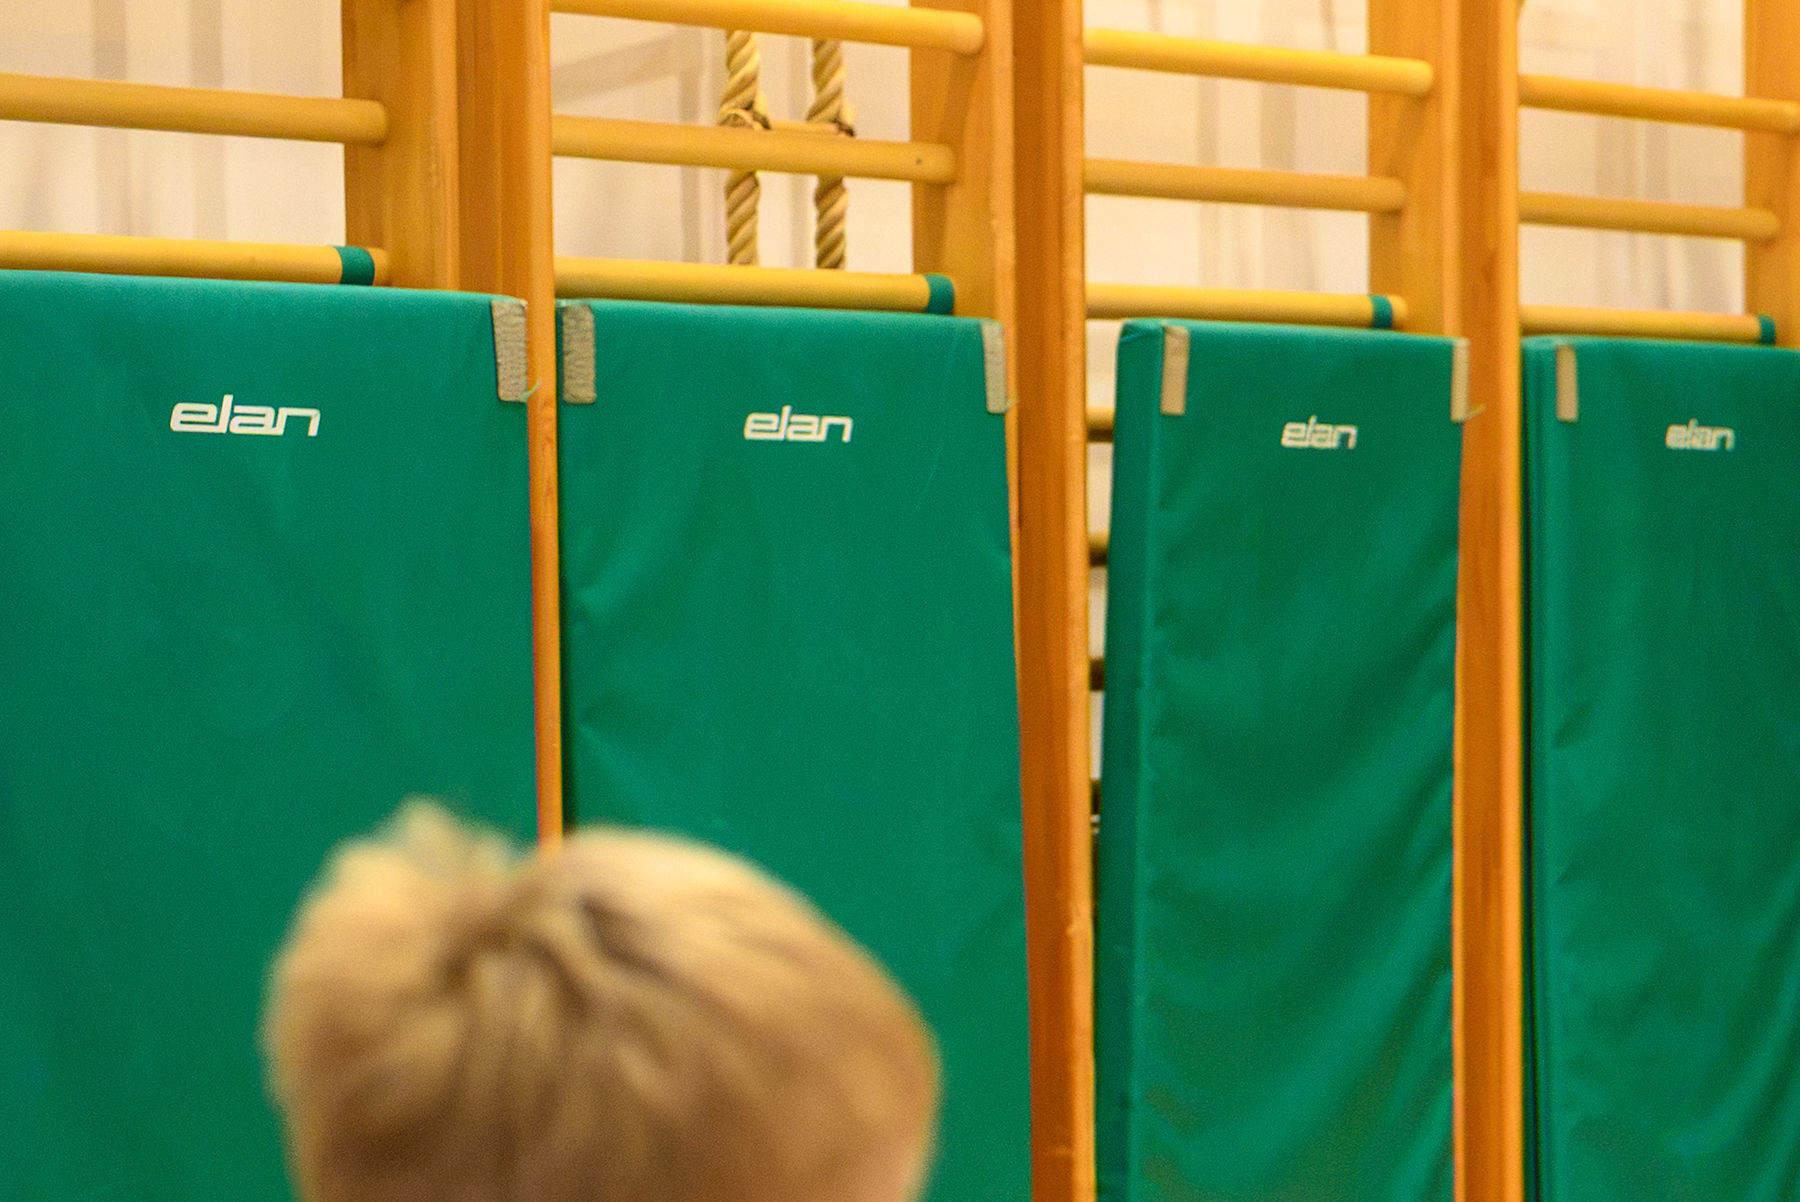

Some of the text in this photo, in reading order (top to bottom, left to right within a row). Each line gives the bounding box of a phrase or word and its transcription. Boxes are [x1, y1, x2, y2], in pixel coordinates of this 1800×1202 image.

[170, 395, 321, 437] elan
[743, 405, 853, 443] elan
[1281, 415, 1358, 449] elan
[1665, 419, 1735, 451] elan
